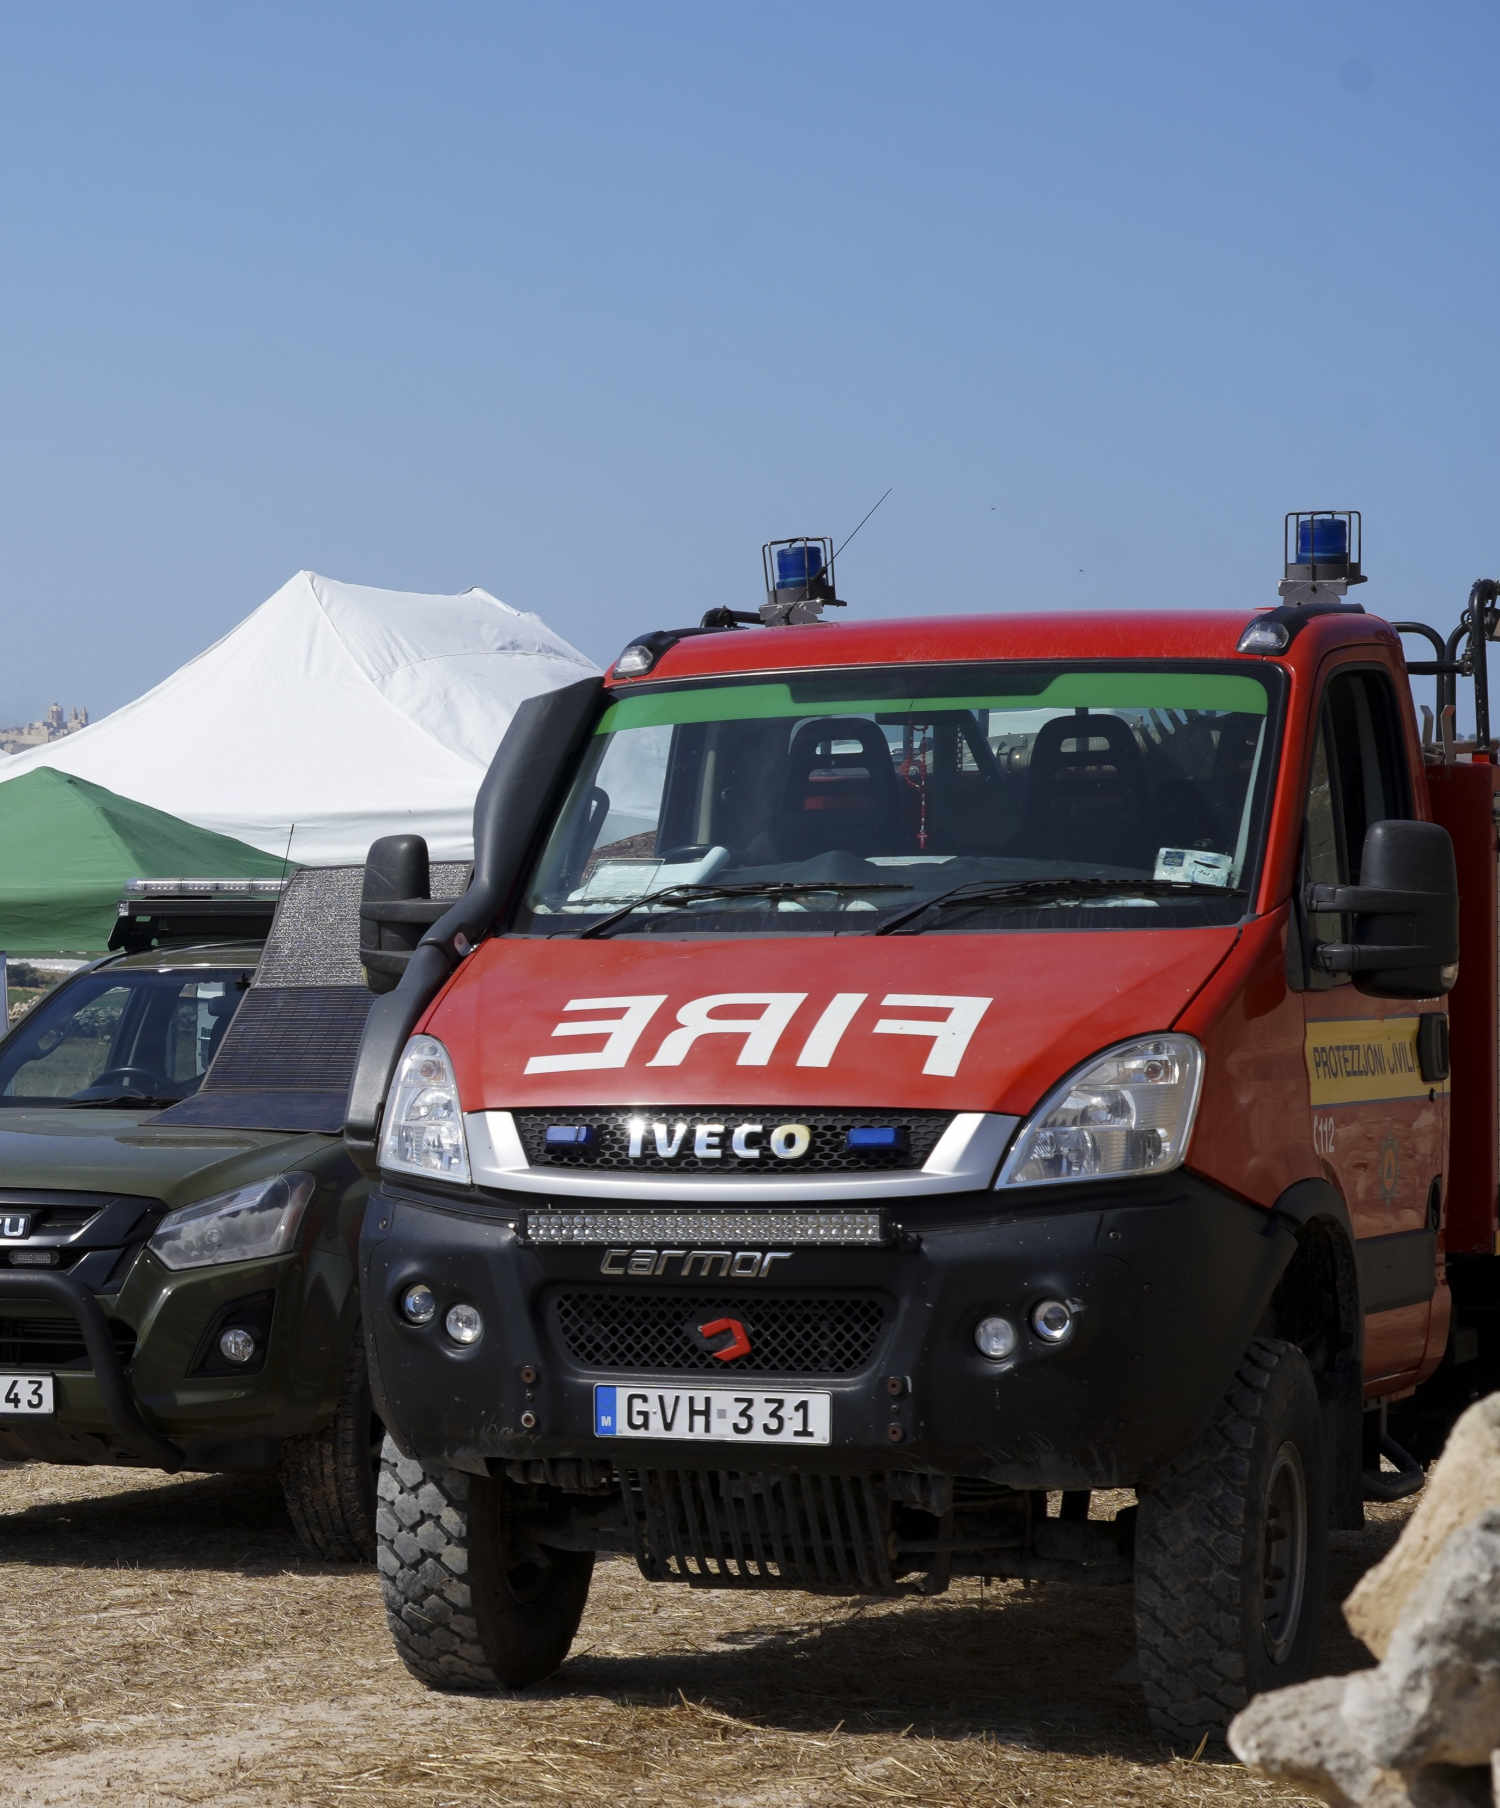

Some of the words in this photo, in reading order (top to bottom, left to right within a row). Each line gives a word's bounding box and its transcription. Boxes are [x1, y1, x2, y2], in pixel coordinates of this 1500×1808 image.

[1313, 1043, 1387, 1080] PROTEZZJONI
[627, 1122, 812, 1161] IVECO
[1318, 1116, 1335, 1154] 112
[600, 1249, 793, 1278] carmor
[601, 1416, 612, 1427] M
[627, 1393, 712, 1433] GVH
[732, 1397, 814, 1437] 331
